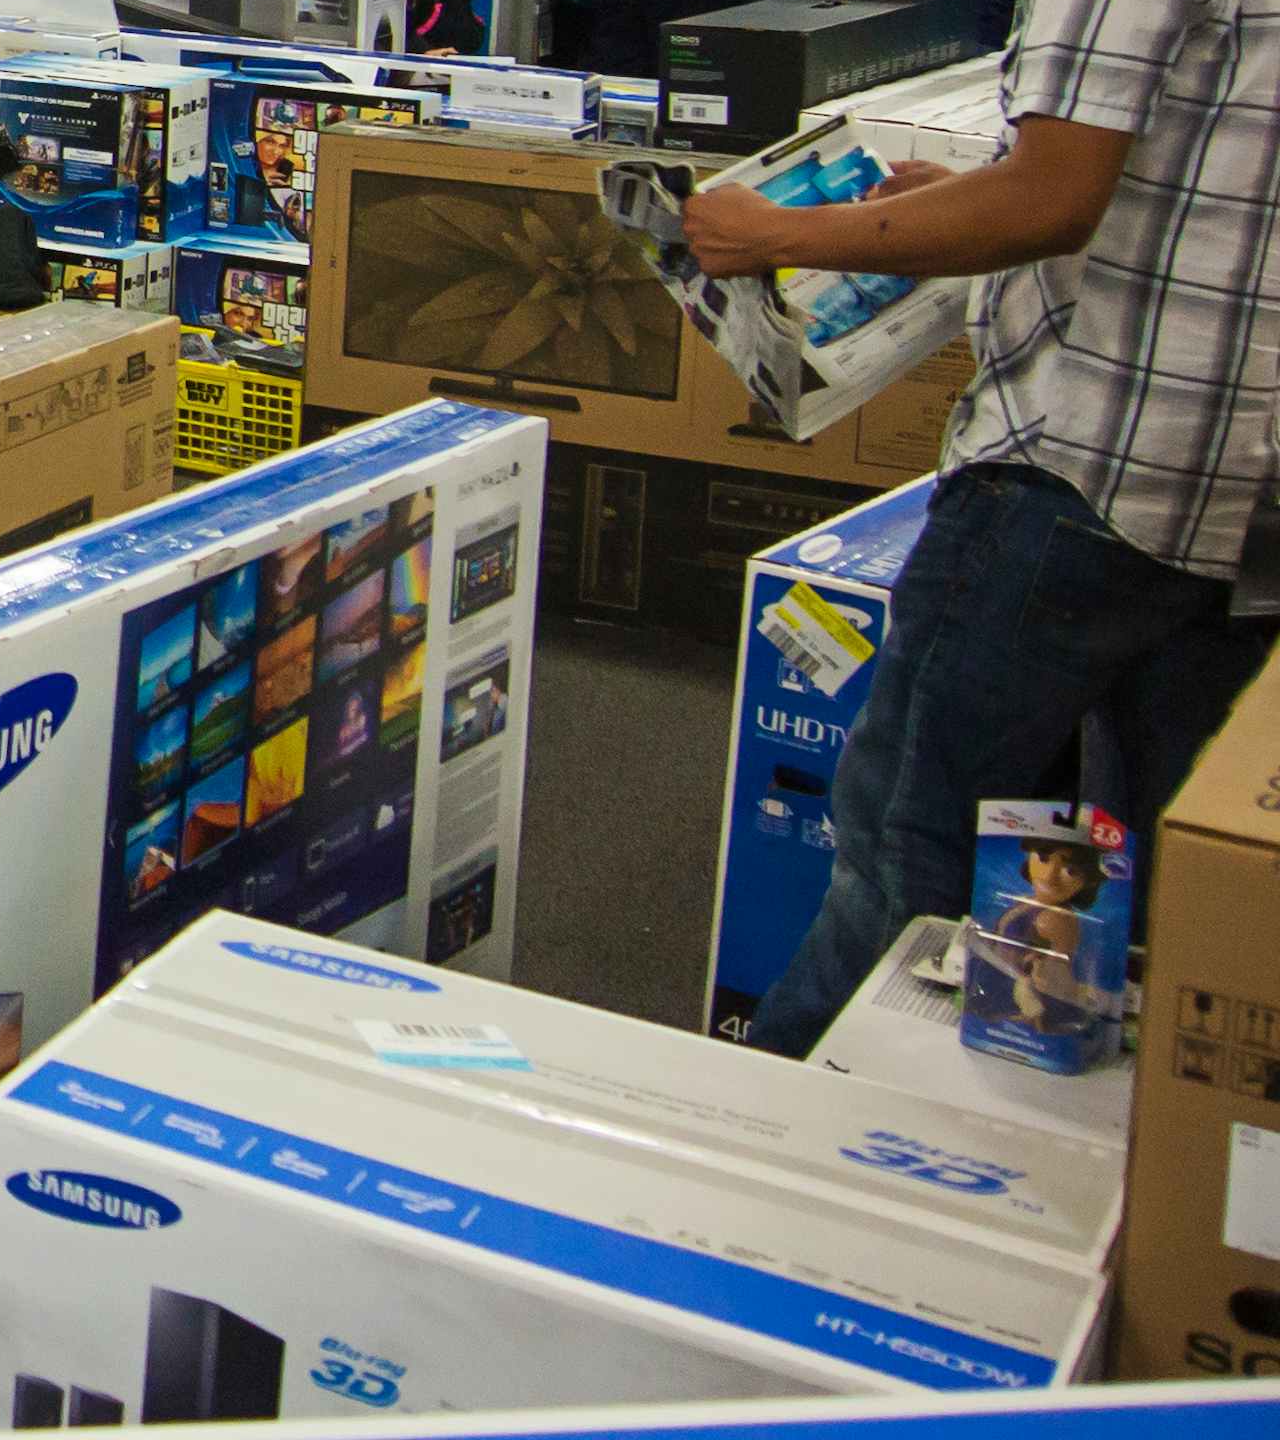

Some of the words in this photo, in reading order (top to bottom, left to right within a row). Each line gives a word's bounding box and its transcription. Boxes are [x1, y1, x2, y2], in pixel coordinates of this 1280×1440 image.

[185, 380, 226, 394] BEST
[187, 391, 221, 406] BUY
[757, 705, 824, 742] UHD
[1092, 825, 1123, 845] 2.0
[248, 941, 414, 992] SAMSUNG
[839, 1145, 1011, 1197] 3D
[26, 1168, 161, 1231] SAMSUNG
[309, 1359, 400, 1408] 3D
